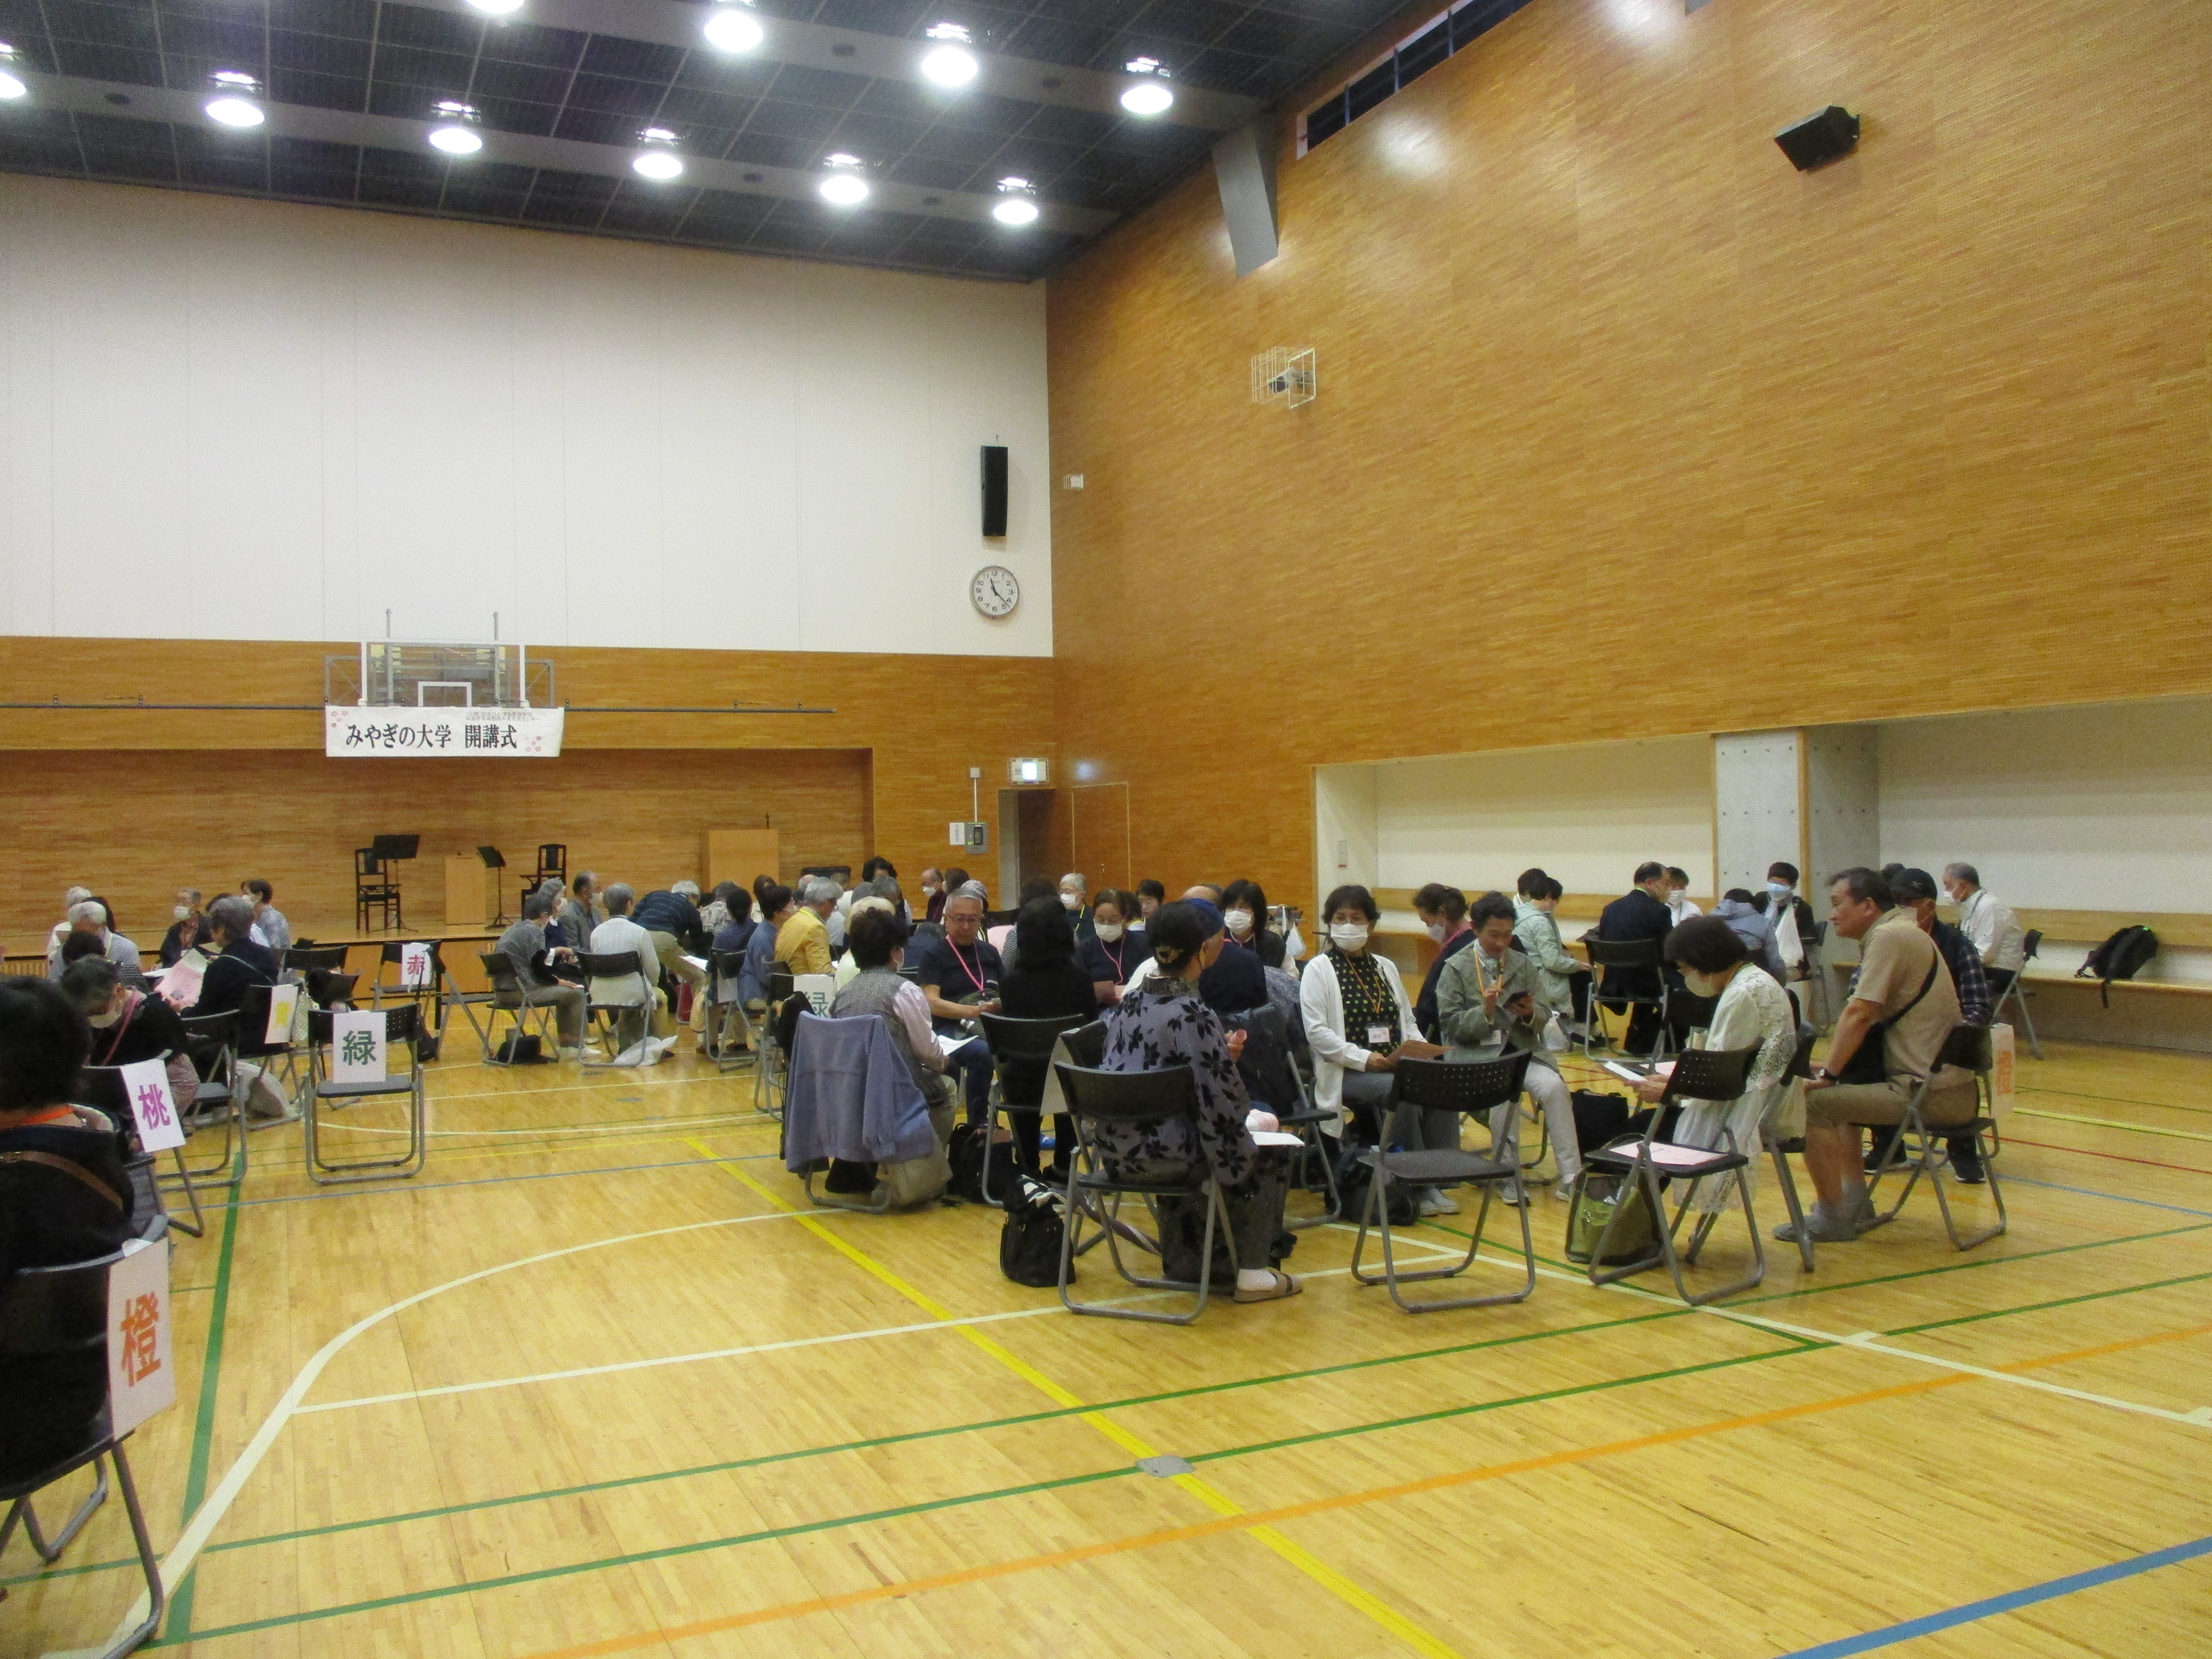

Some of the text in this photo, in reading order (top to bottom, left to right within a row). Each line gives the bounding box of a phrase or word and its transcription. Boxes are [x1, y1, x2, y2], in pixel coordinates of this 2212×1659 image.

[346, 724, 517, 749] みやぎの大学 開講式
[407, 954, 425, 975] 赤
[343, 1030, 377, 1066] 緑
[138, 1083, 170, 1130] 桃
[120, 1291, 161, 1387] 橙
